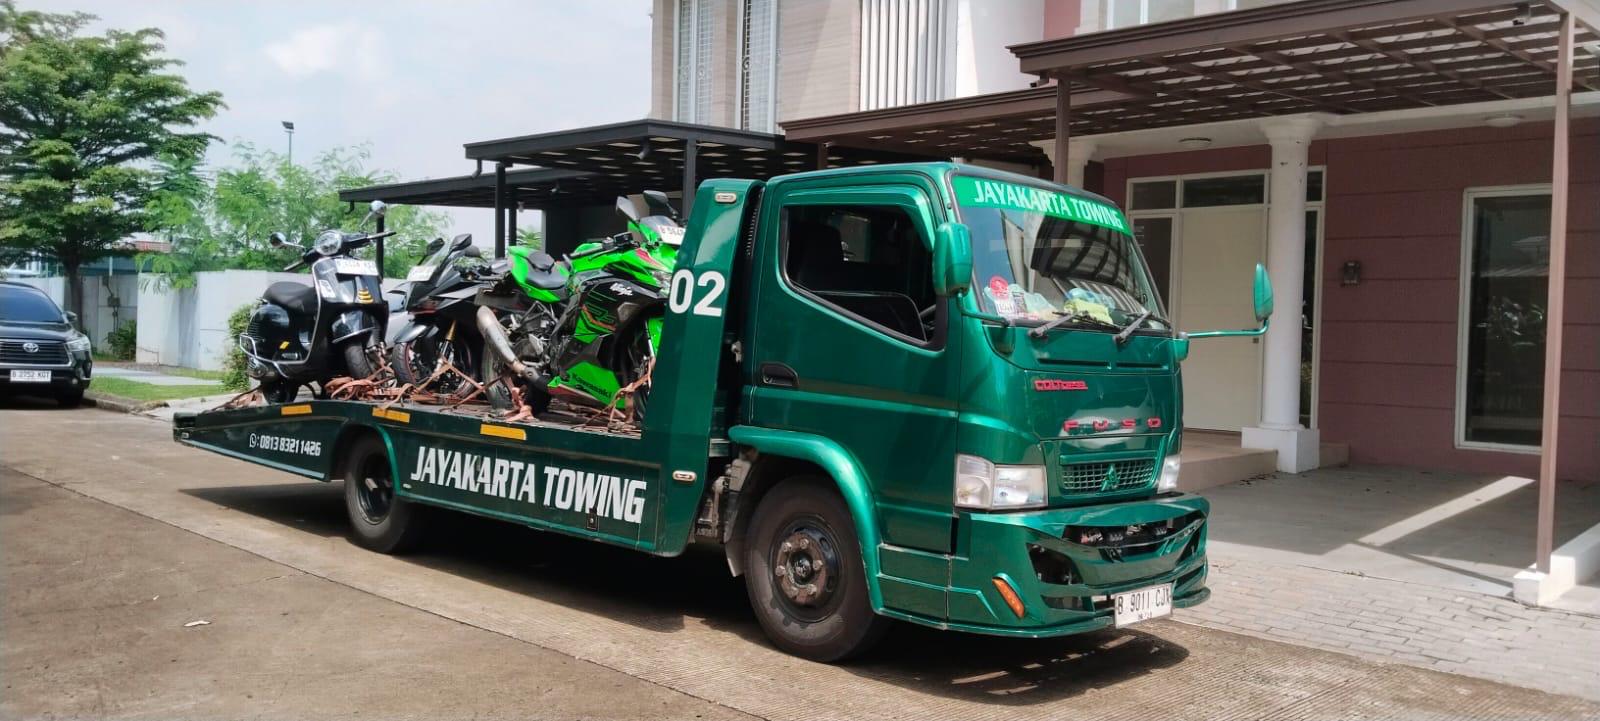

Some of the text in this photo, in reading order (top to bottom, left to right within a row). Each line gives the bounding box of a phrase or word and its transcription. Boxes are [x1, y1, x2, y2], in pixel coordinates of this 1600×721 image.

[974, 181, 1124, 230] JAYAKARTA TOWING
[669, 268, 726, 317] 02
[1062, 417, 1162, 433] FUSO
[411, 446, 647, 524] JAYAKARTA TOWING
[1117, 595, 1125, 615] B
[1130, 591, 1150, 613] 9011
